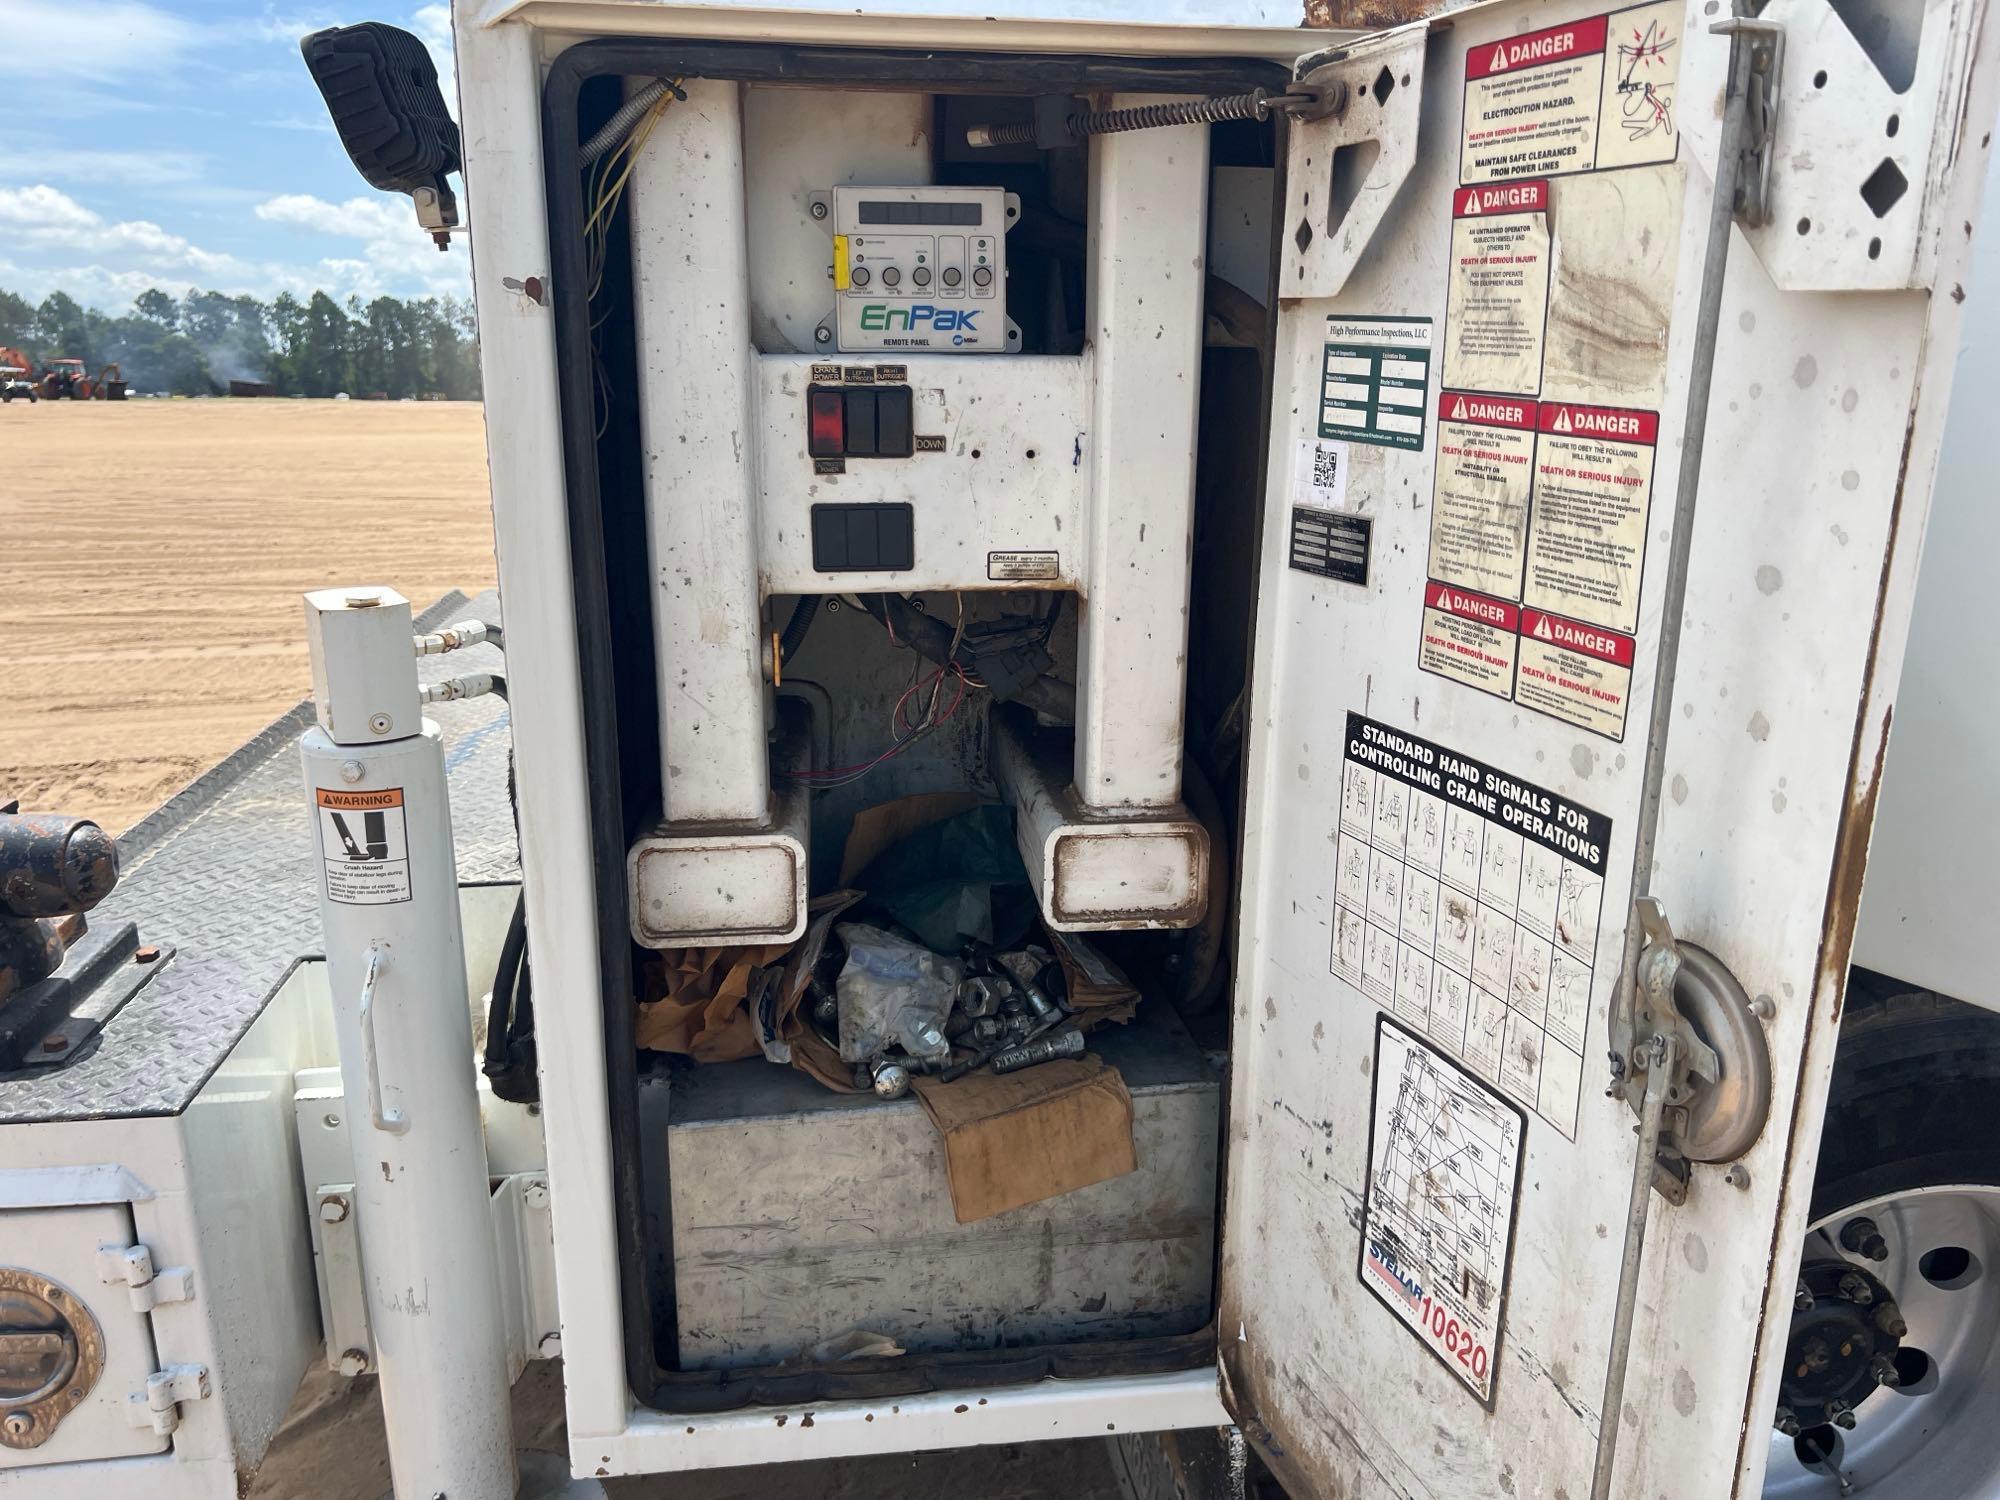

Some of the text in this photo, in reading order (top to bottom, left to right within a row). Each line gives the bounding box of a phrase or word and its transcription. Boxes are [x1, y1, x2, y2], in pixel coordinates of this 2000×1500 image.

[1511, 33, 1574, 63] DANGER
[1491, 82, 1506, 90] remote
[1507, 78, 1523, 86] control
[1554, 67, 1572, 77] provide
[1573, 66, 1582, 74] you
[1502, 88, 1515, 96] others
[1517, 85, 1526, 93] with
[1527, 81, 1550, 92] protection
[1552, 78, 1568, 88] against
[1483, 97, 1575, 120] ELECTROCUTION HAZARD.
[1469, 133, 1485, 141] DEATH
[1495, 127, 1517, 136] SERIOUS
[1519, 124, 1538, 132] INJURY
[1548, 120, 1560, 128] result
[1502, 135, 1516, 144] should
[1517, 133, 1534, 142] become
[1536, 128, 1561, 139] electrically
[1475, 146, 1576, 167] MAINTAIN SAFE CLEARANCES
[1491, 161, 1559, 177] FROM POWER LINES
[1484, 187, 1538, 207] DANGER
[1477, 227, 1503, 235] UNTRAINED
[1505, 225, 1530, 233] OPERATOR
[860, 305, 980, 331] EnPak
[1330, 326, 1427, 339] High Performance Inspections, LLC
[813, 373, 839, 381] POWER
[1470, 404, 1523, 423] DANGER
[1575, 413, 1640, 435] DANGER
[917, 440, 944, 448] DOWN
[1478, 439, 1495, 447] RESULT
[1495, 433, 1521, 442] FOLLOWING
[1442, 447, 1461, 455] DEATH
[1474, 450, 1501, 460] SERIOUS
[1503, 455, 1528, 465] INJURY
[1549, 441, 1569, 449] FAILURE
[1578, 444, 1592, 452] OBEY
[1606, 448, 1638, 459] FOLLOWING
[1572, 453, 1584, 461] WILL
[1585, 455, 1605, 463] RESULT
[1463, 462, 1491, 472] INSTABILITY
[1540, 465, 1643, 487] DEATH OR SERIOUS INJURY
[1455, 470, 1507, 483] STRUCTURAL DAMAGE
[1454, 595, 1504, 622] DANGER
[1461, 621, 1485, 634] PERSONNEL
[1450, 632, 1460, 640] WILL
[1461, 636, 1476, 646] RESULT
[1555, 624, 1616, 655] DANGER
[1426, 635, 1445, 647] DEATH
[1447, 642, 1455, 651] OR
[1457, 645, 1483, 660] SERIOUS
[1485, 655, 1508, 668] INJURY
[1543, 655, 1560, 664] MANUAL
[1561, 660, 1573, 668] BOOM
[1560, 667, 1584, 679] WILL CAUSE
[1522, 666, 1621, 705] DEATH OR SERIOUS INJURY
[1362, 724, 1589, 834] STANDARD HAND SIGNALS FOR
[332, 795, 392, 805] WARNING
[1350, 740, 1600, 864] CONTROLLING CRANE OPERATIONS
[1369, 1240, 1424, 1300] STELLAR
[1420, 1296, 1487, 1379] 10620
